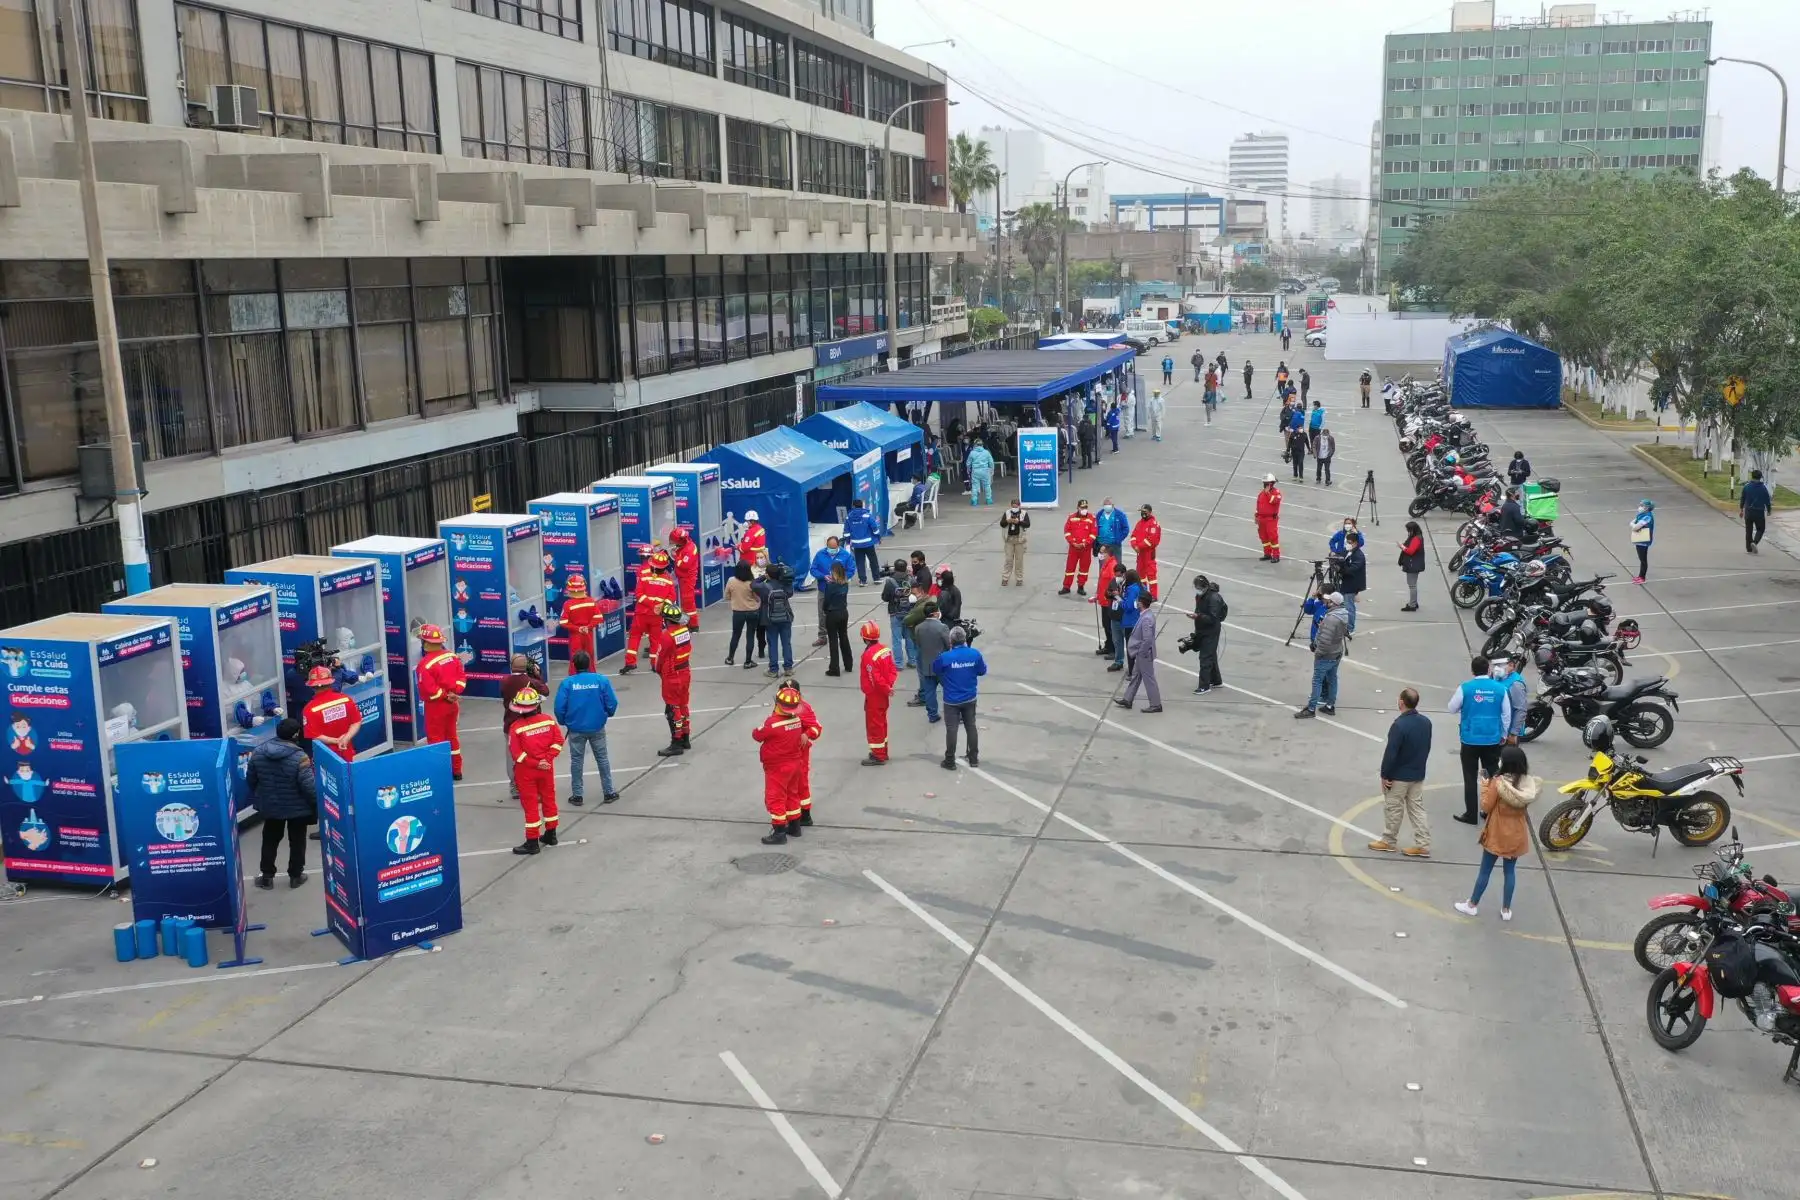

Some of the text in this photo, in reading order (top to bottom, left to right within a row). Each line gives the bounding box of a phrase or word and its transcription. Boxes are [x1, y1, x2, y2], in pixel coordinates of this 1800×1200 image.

[829, 346, 842, 359] BBVA
[821, 440, 849, 449] Salud
[721, 477, 761, 490] sSalud
[30, 650, 66, 660] EsSalud
[31, 660, 68, 669] Te Cuida
[7, 683, 69, 695] Cumple estas
[12, 694, 68, 706] indicaciones
[168, 771, 200, 779] EsSalud
[180, 777, 202, 785] Cuida
[400, 778, 430, 790] EsSalud
[411, 785, 431, 794] Cuida
[380, 869, 402, 880] JUNTOS
[422, 858, 441, 867] SALUD
